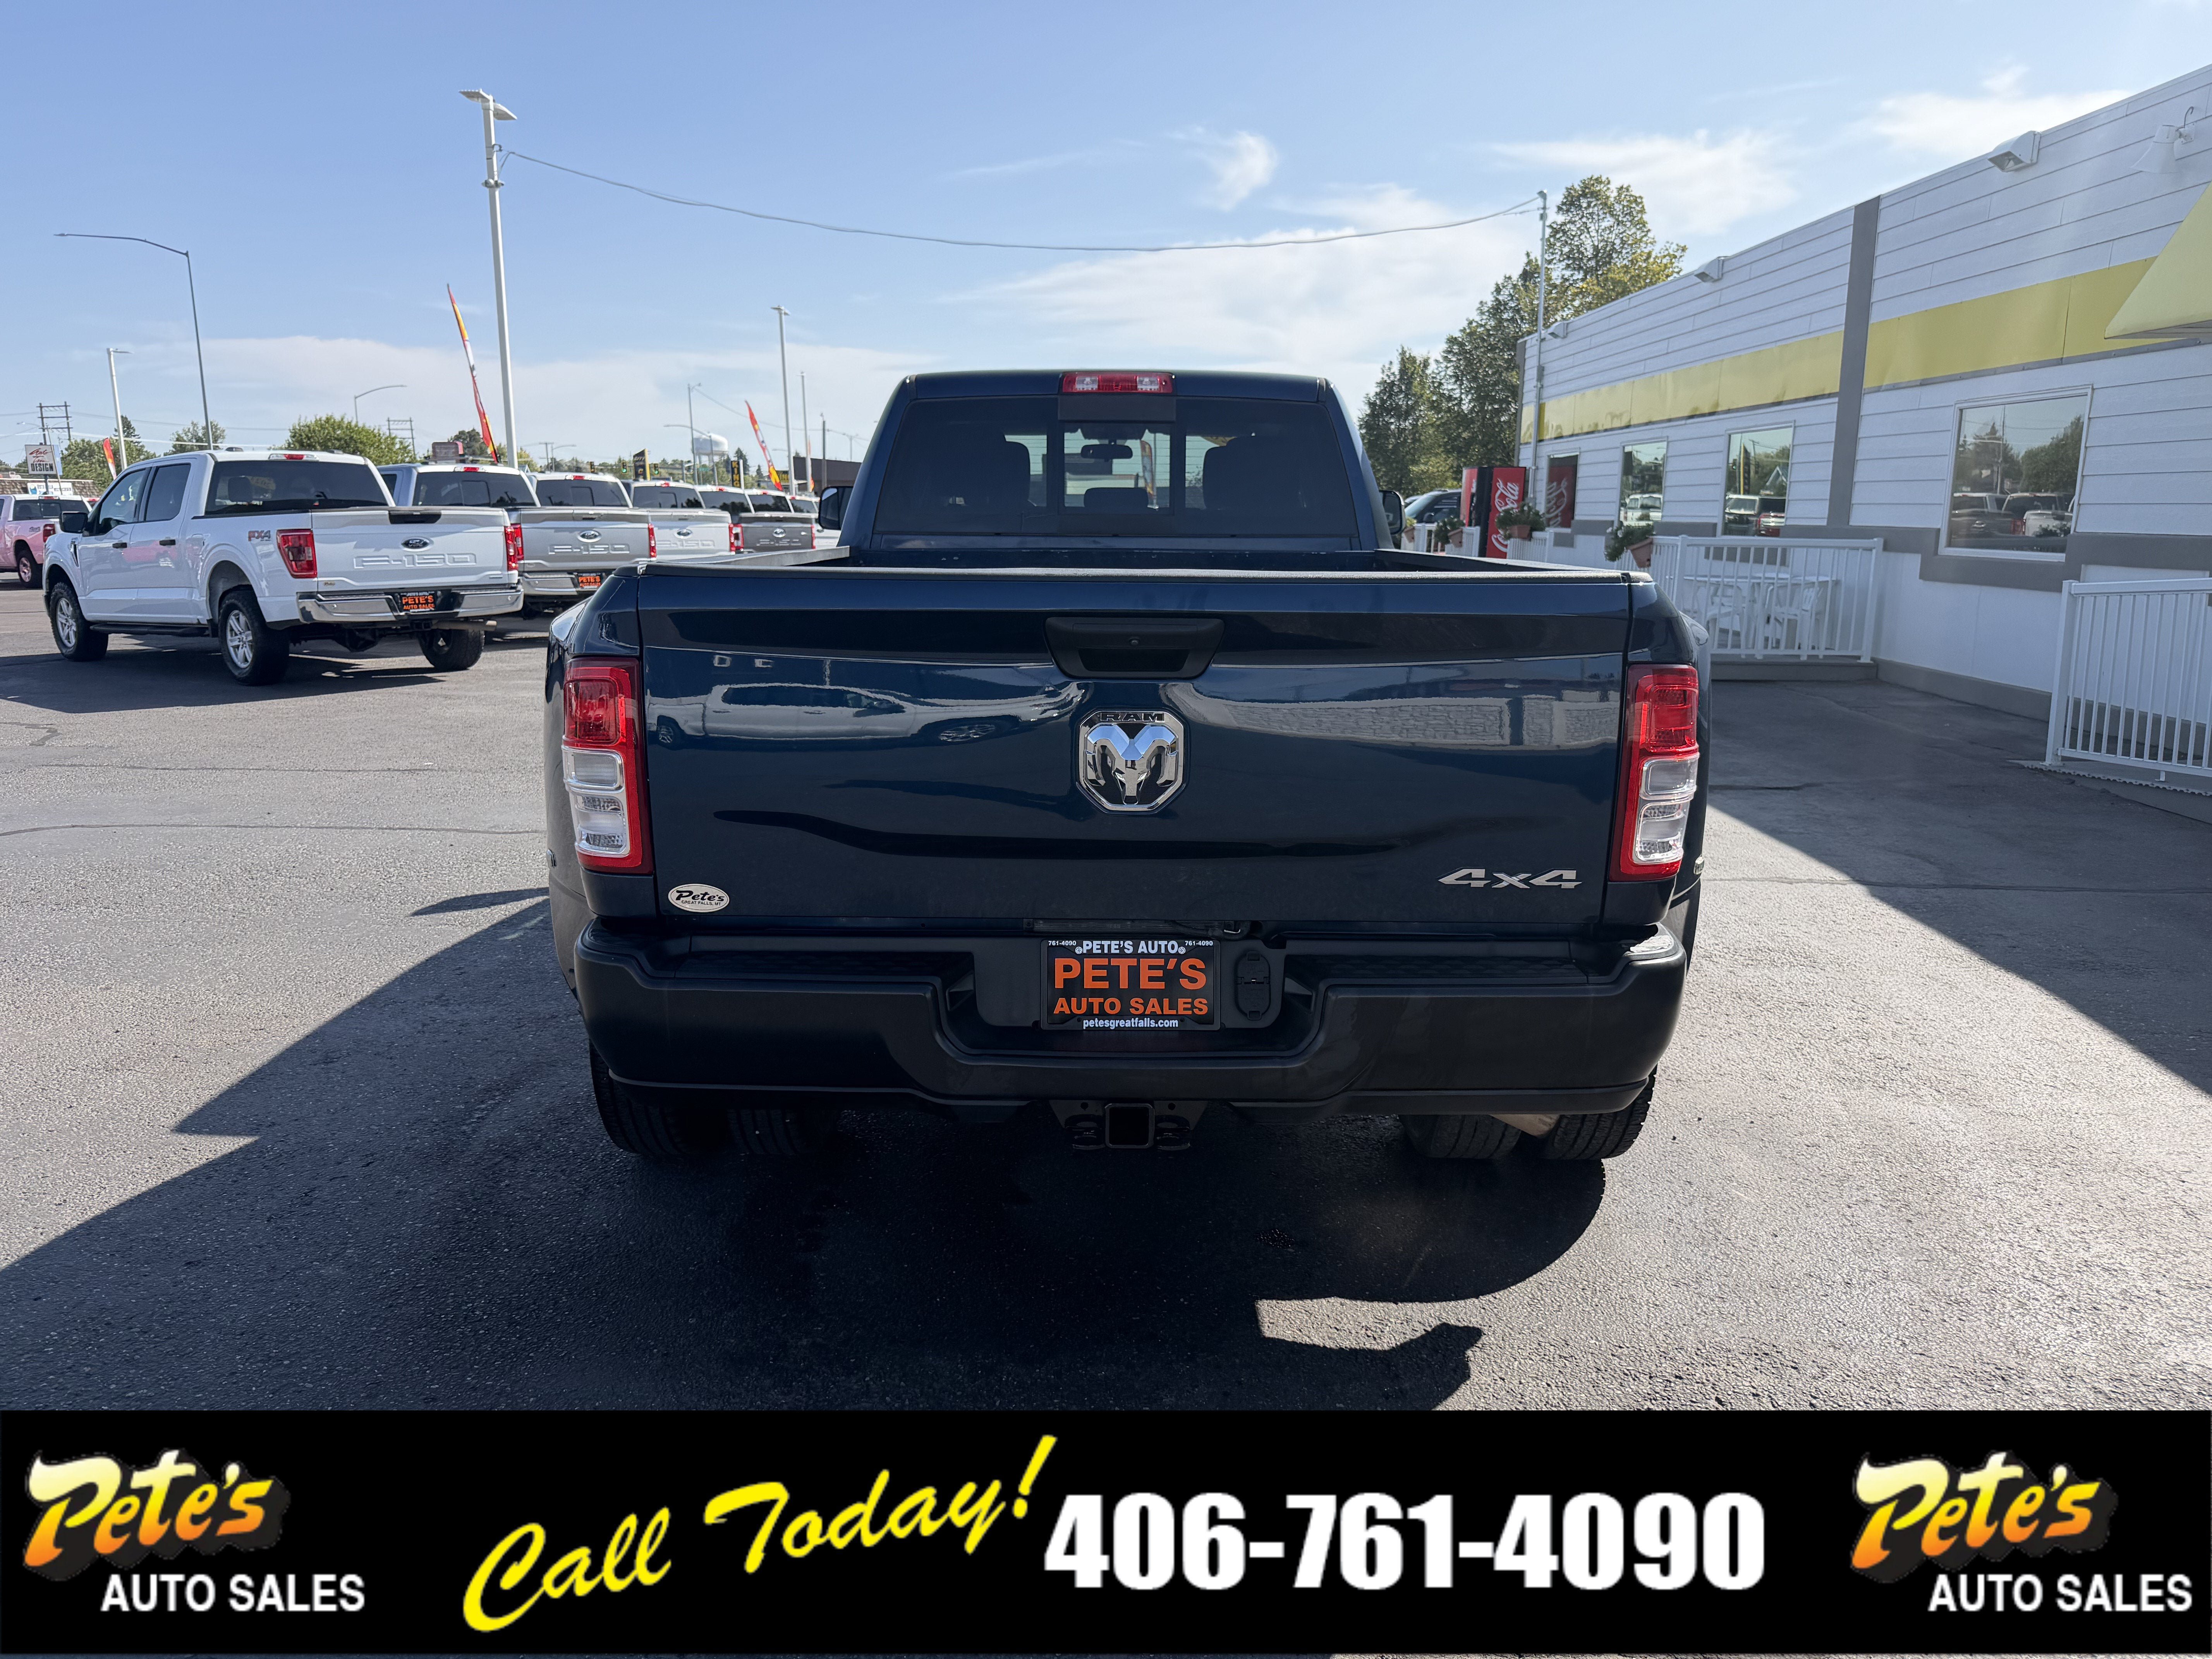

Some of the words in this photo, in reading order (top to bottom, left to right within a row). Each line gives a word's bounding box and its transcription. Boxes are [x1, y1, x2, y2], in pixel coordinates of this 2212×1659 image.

[31, 463, 53, 471] DESIGN
[248, 530, 271, 541] FX4
[548, 544, 630, 555] F-150
[353, 553, 477, 568] F-150
[402, 595, 434, 604] PETE'S
[1100, 713, 1164, 722] RAM
[676, 890, 725, 902] Pete's
[1083, 940, 1133, 954] PETE'S
[1138, 940, 1178, 954] AUTO
[1054, 958, 1207, 989] PETE'S
[1053, 998, 1121, 1014] AUTO
[1130, 998, 1208, 1015] SALES
[1083, 1017, 1178, 1029] petesgreatfalls.com
